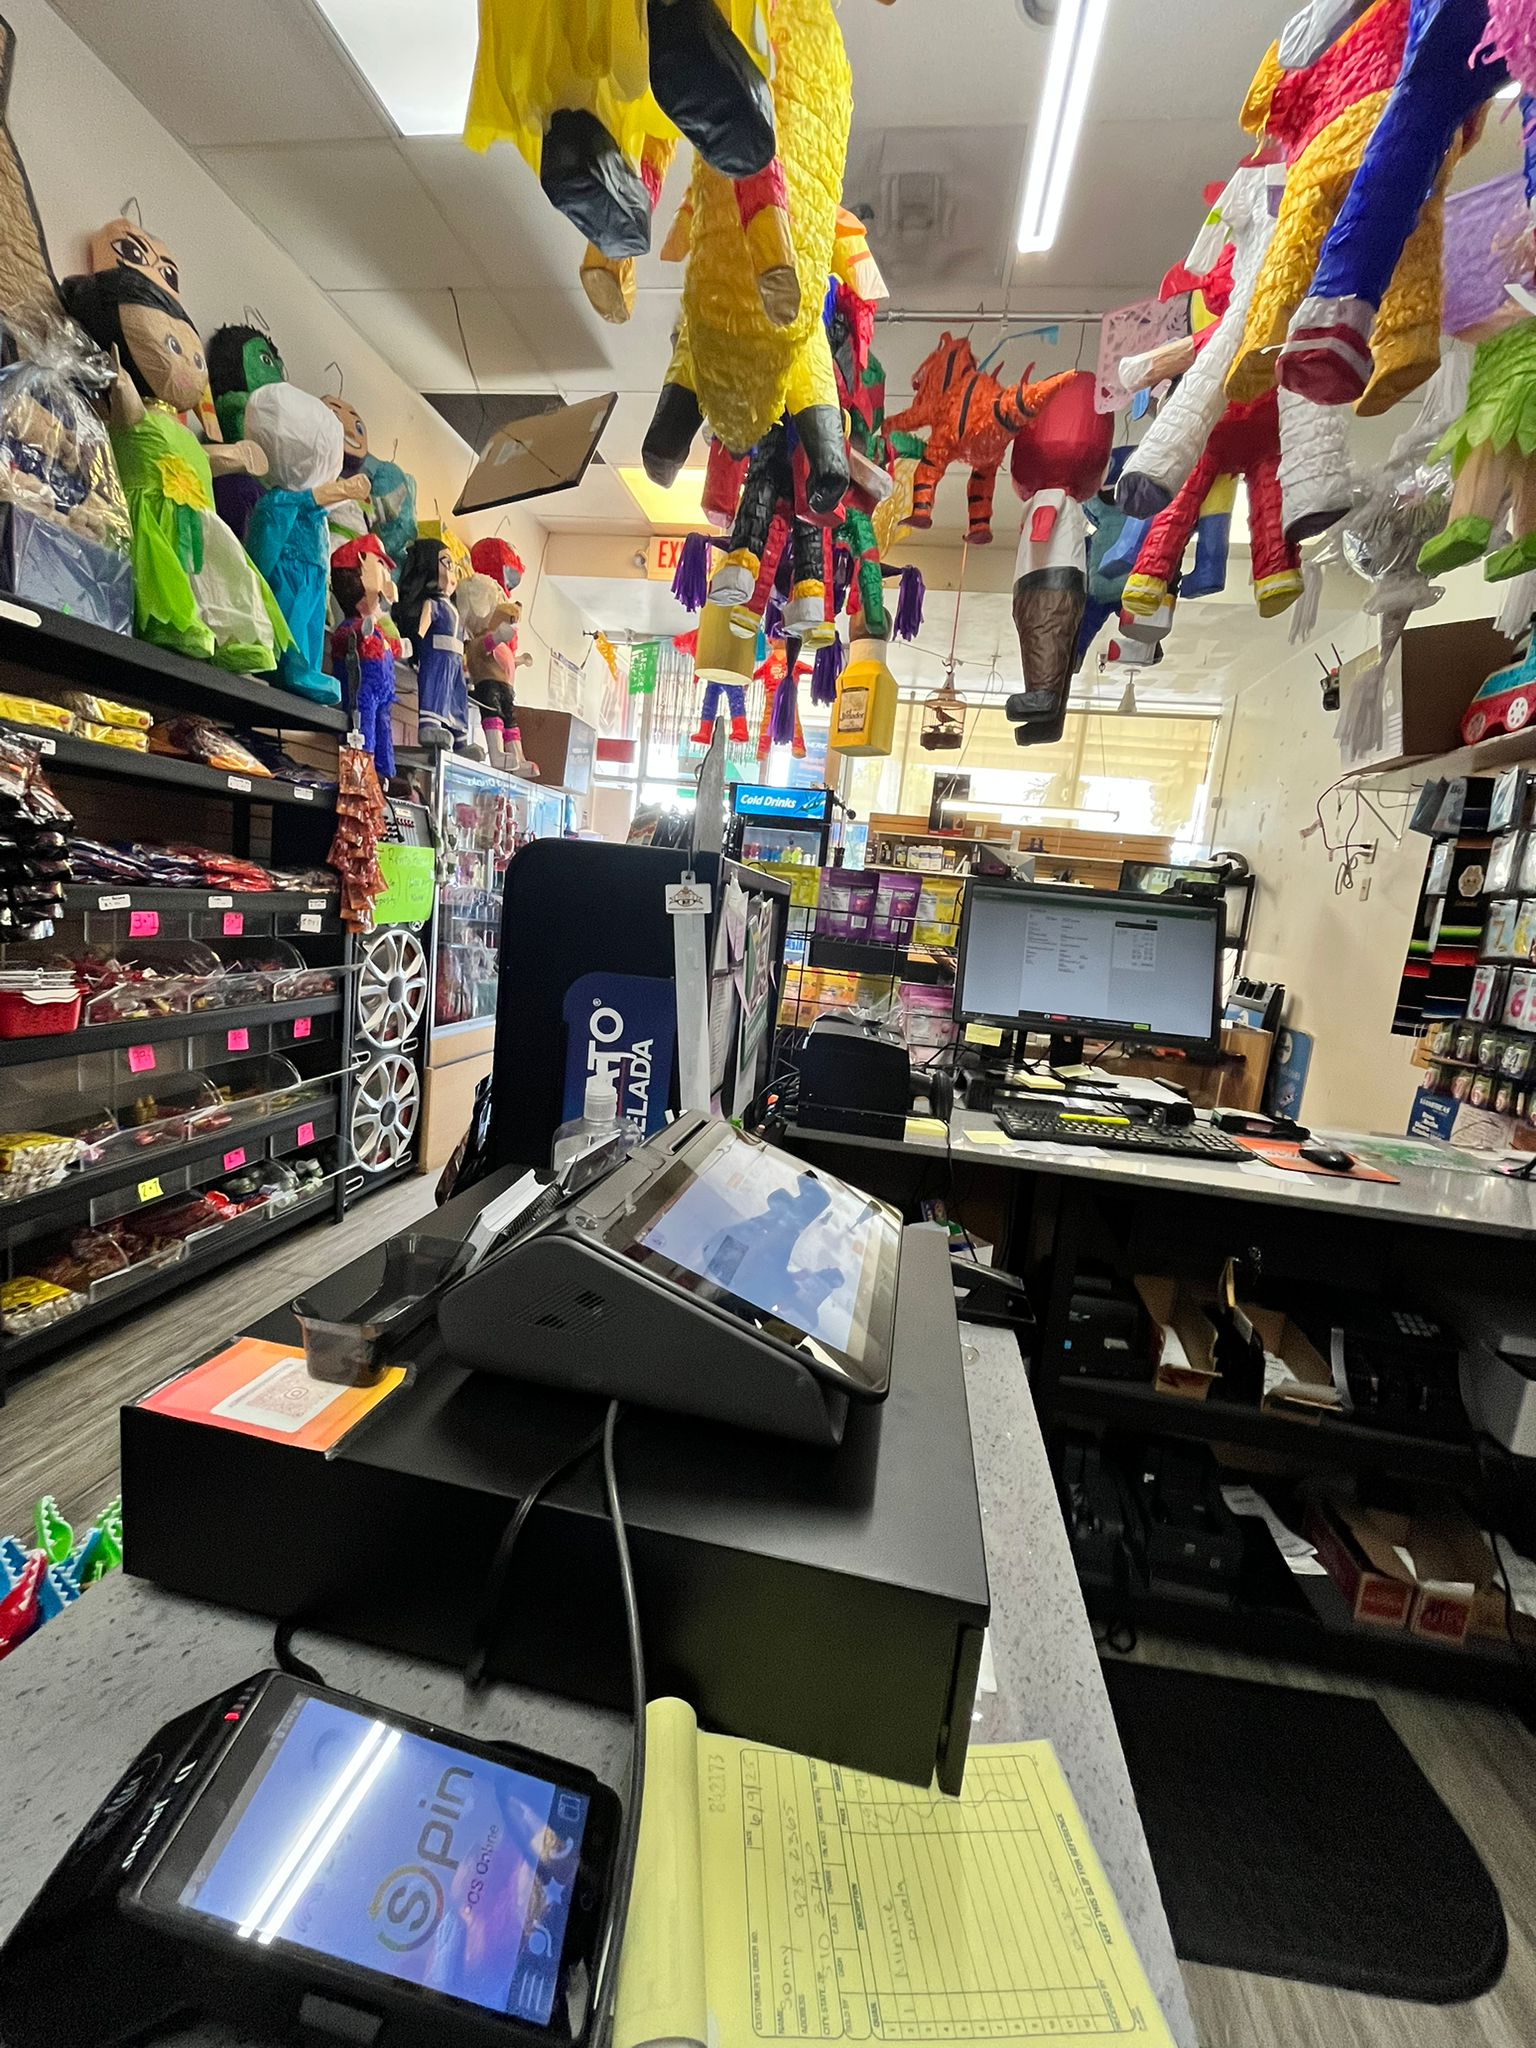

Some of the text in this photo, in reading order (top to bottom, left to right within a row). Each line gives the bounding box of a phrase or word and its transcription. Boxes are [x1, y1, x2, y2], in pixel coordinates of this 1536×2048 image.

[740, 794, 797, 809] Cold Drinks
[833, 1769, 841, 1792] AMOUNT
[369, 1766, 474, 1952] Spin
[1057, 1813, 1113, 1945] KEEP THIS SLIP FOR REFERENCE
[852, 1883, 864, 1931] DESCRIPTION
[752, 1945, 760, 1973] ORDER
[752, 1974, 762, 2030] CUSTOMER'S
[777, 2008, 785, 2034] NAME
[799, 1994, 808, 2033] ADDRESS
